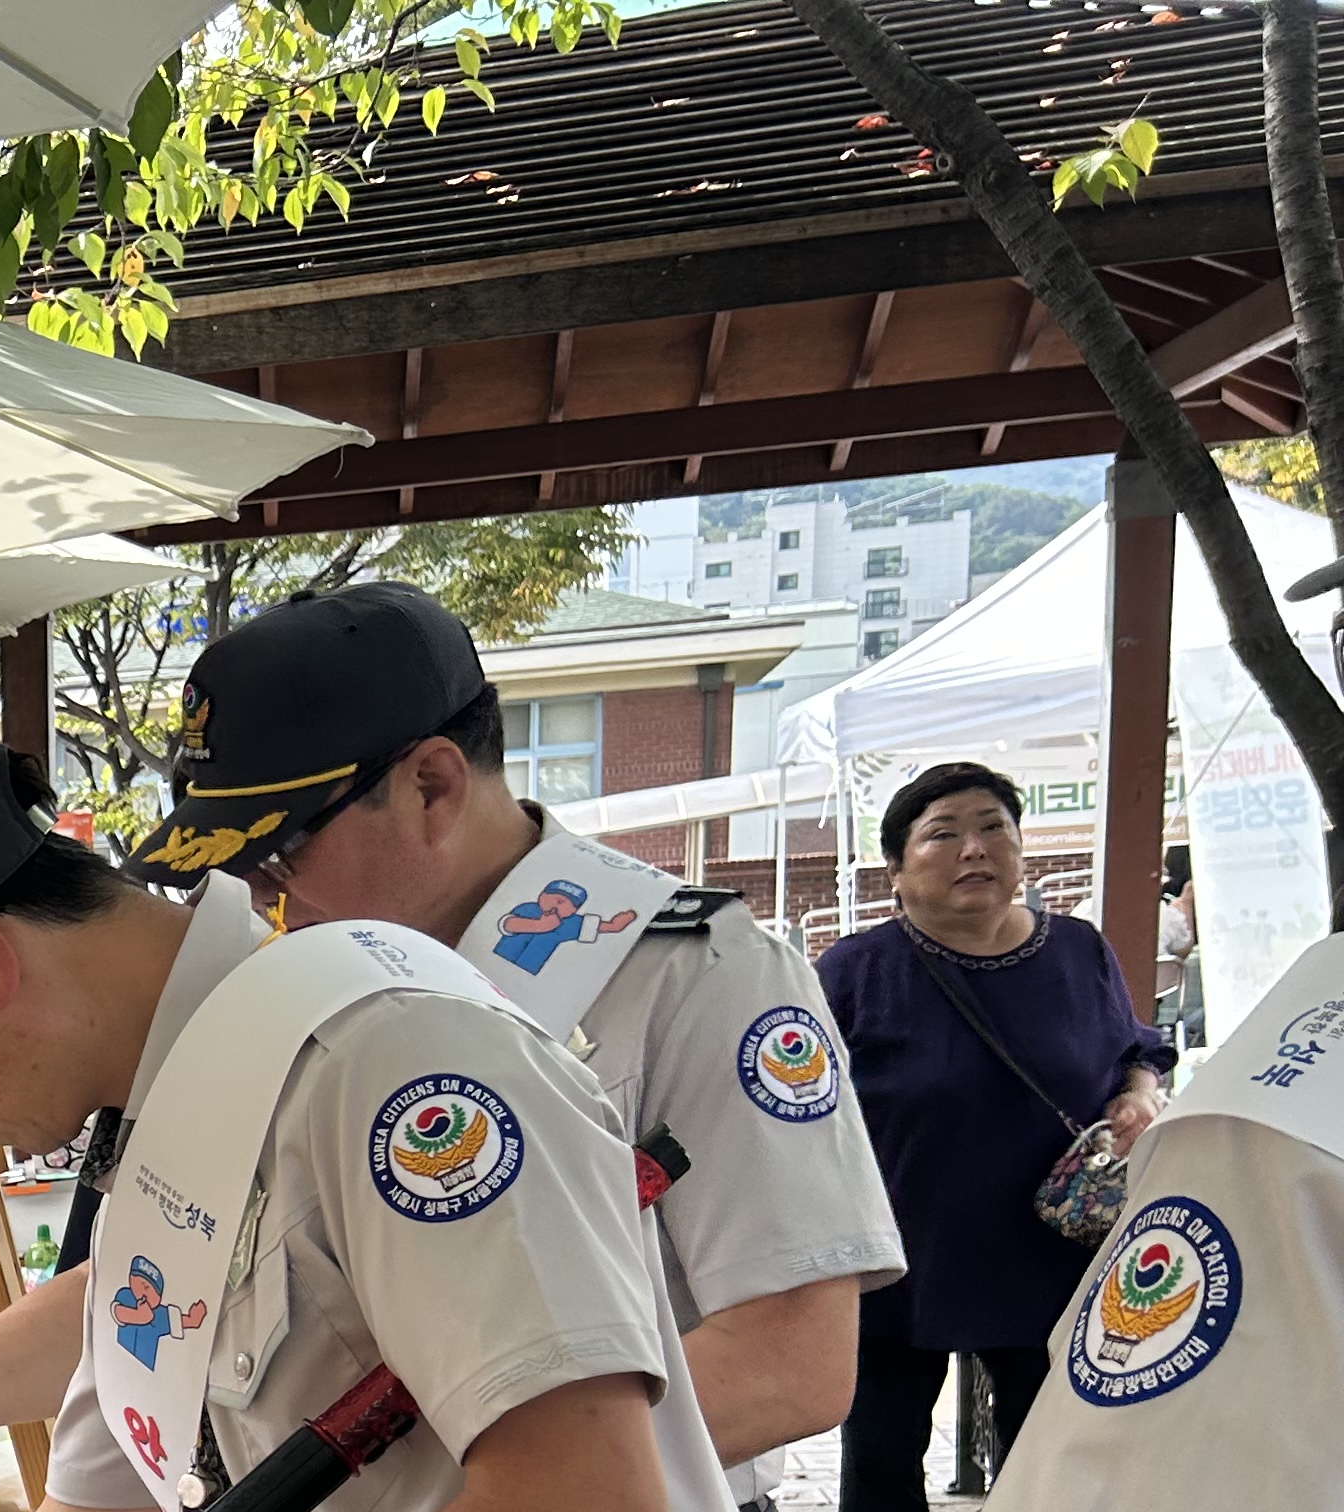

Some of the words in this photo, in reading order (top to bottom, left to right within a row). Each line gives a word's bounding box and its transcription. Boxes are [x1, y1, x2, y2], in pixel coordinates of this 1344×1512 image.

[1250, 1040, 1326, 1088] 성북
[373, 1128, 390, 1173] KOREA
[382, 1080, 435, 1124] CITIZENS
[440, 1079, 460, 1092] ON
[463, 1083, 508, 1122] PATROL
[387, 1185, 421, 1214] 서울시
[423, 1197, 462, 1216] 성북구
[463, 1136, 519, 1207] 자율방범연합대
[185, 1202, 216, 1241] 성북
[138, 1258, 160, 1281] SAFE
[1097, 1231, 1131, 1283] KOREA
[1134, 1206, 1190, 1235] CITIZENS
[1186, 1217, 1213, 1245] ON
[1200, 1240, 1230, 1310] PATROL
[1098, 1335, 1211, 1398] 자율방범연합대
